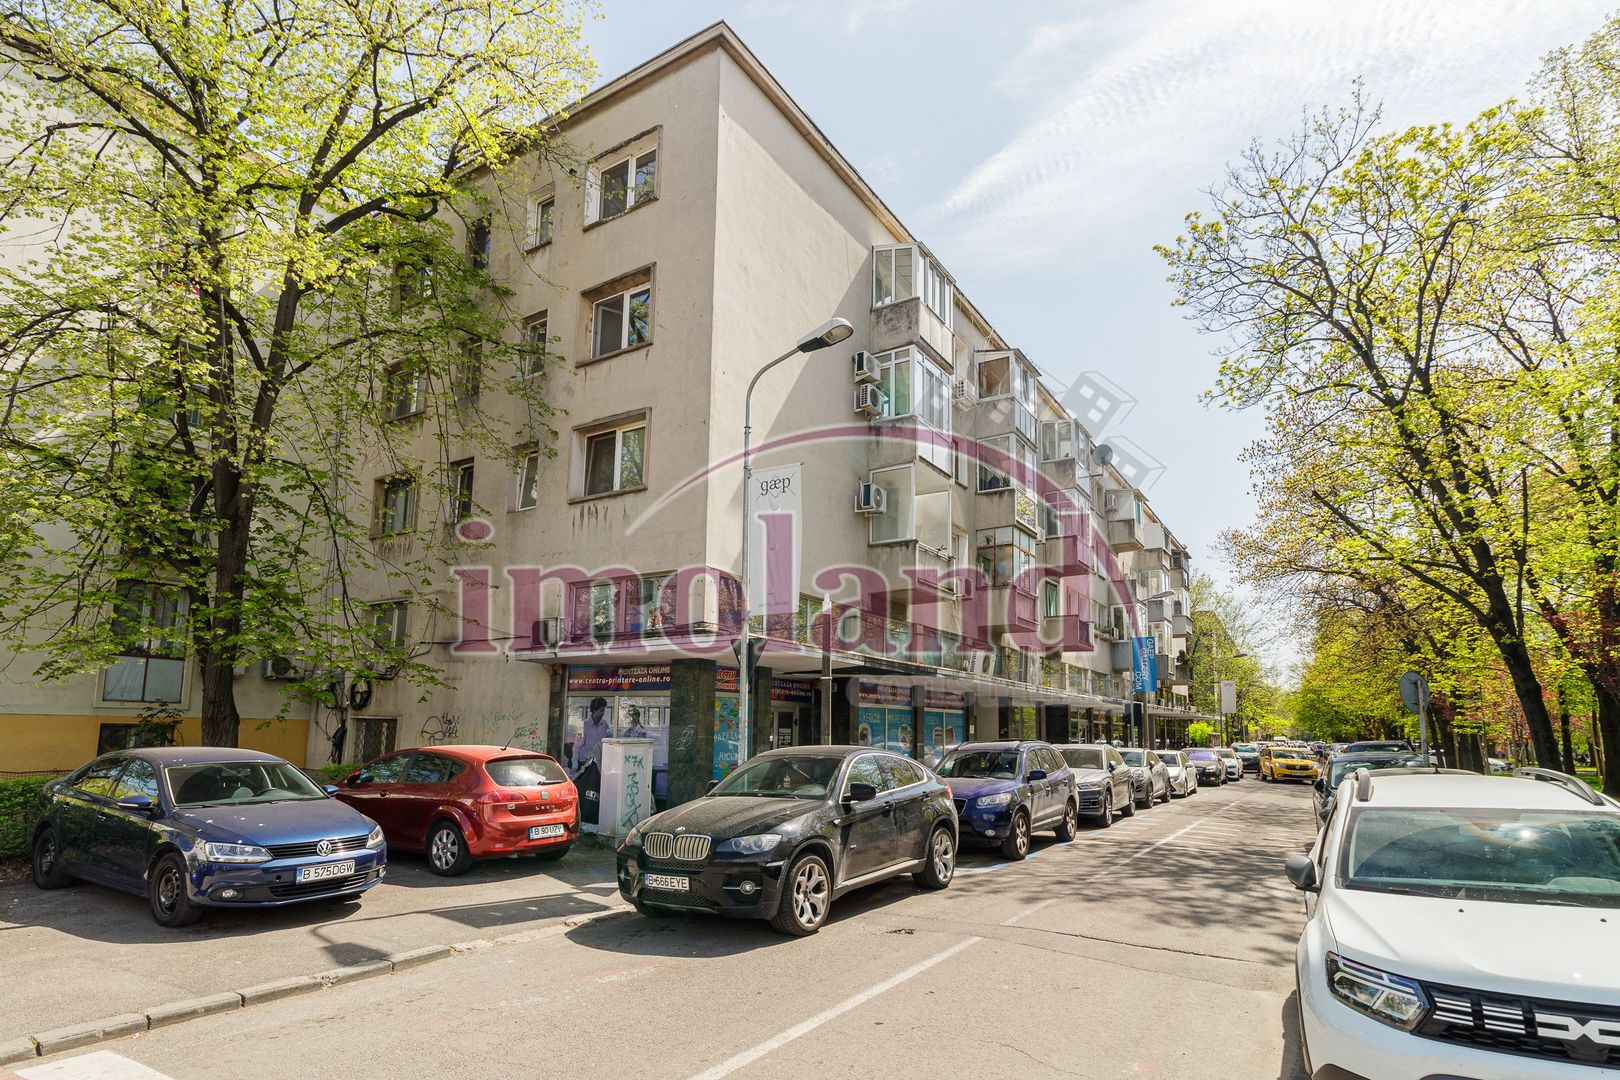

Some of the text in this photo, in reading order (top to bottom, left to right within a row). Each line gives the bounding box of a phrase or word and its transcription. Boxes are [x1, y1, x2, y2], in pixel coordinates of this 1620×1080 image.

[1146, 638, 1155, 659] GAEP
[1140, 647, 1149, 681] GALLERY
[303, 862, 354, 880] B 575DGW
[648, 875, 688, 889] B 666EYE
